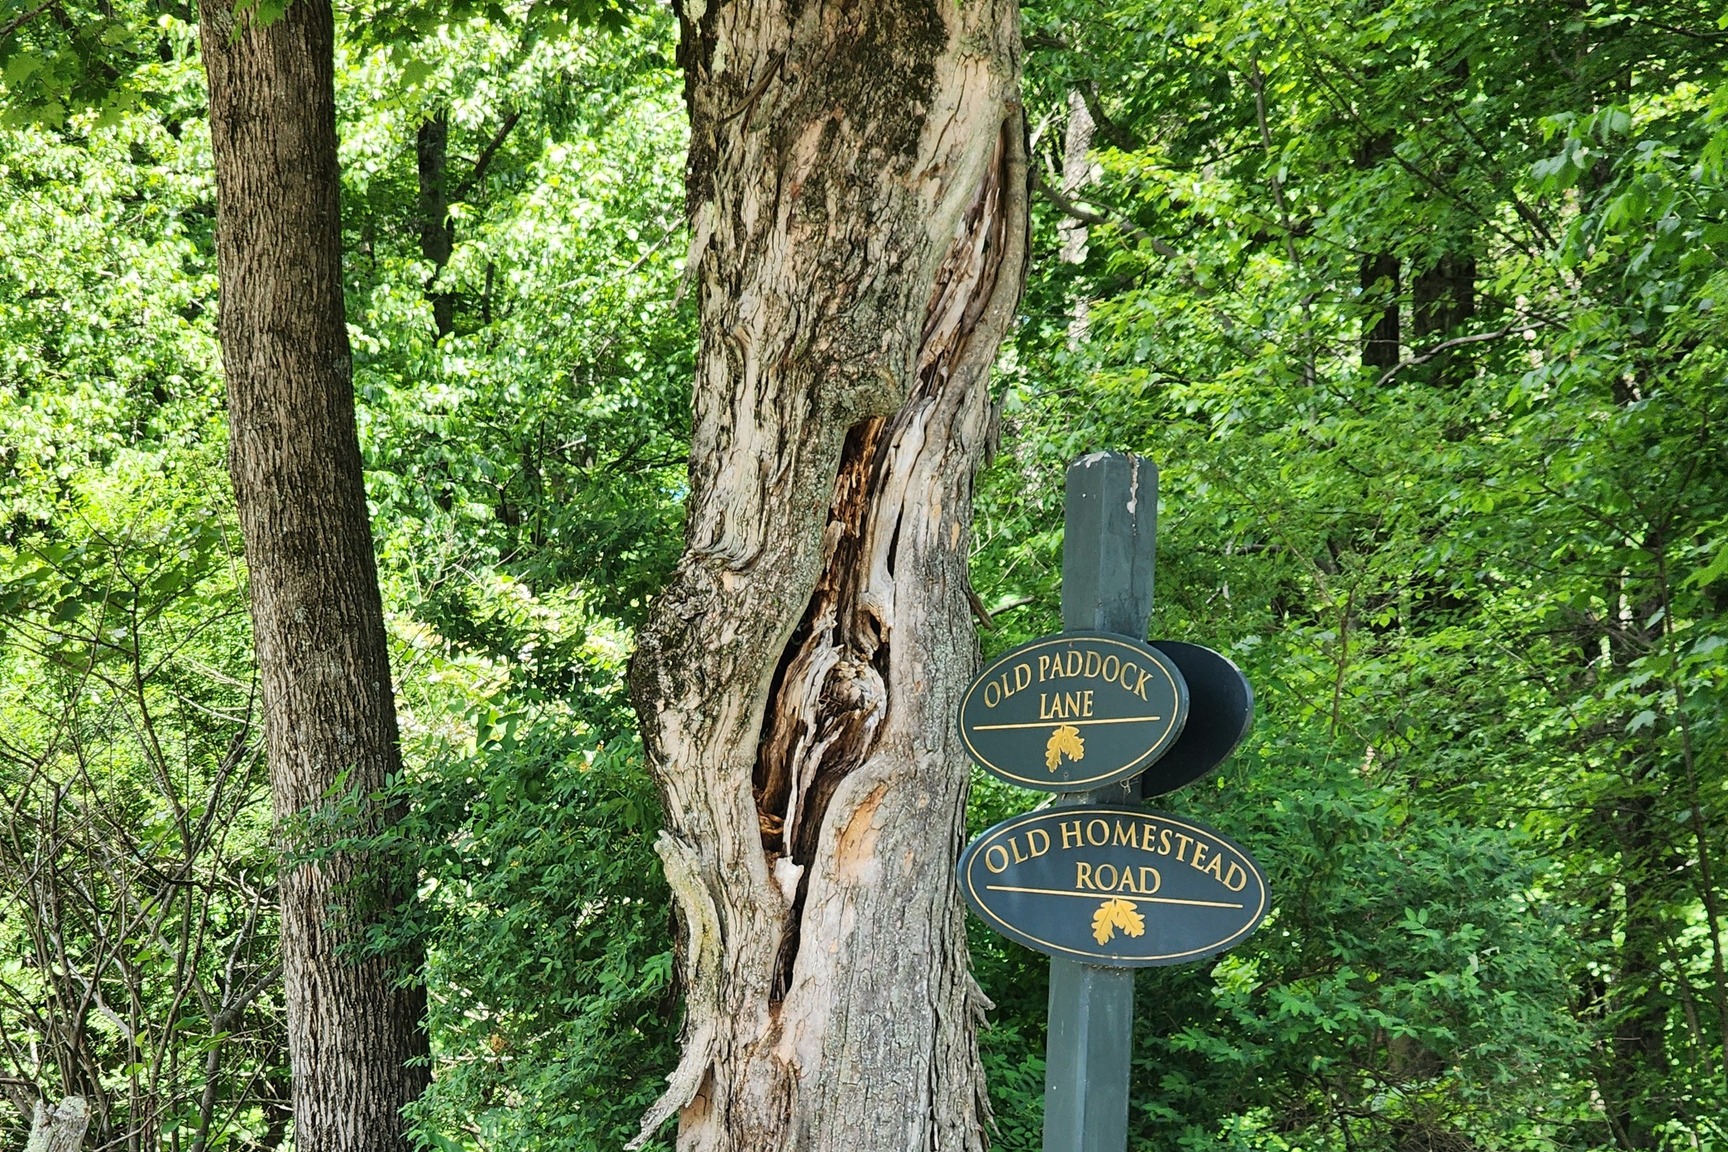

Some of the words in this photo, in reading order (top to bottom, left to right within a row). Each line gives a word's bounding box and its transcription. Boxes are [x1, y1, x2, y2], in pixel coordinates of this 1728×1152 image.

[984, 663, 1032, 708] OLD
[1038, 650, 1153, 701] PADDOCK
[1040, 690, 1094, 720] LANE
[985, 828, 1050, 874] OLD
[1059, 819, 1247, 892] HOMESTEAD
[1076, 862, 1161, 894] ROAD
